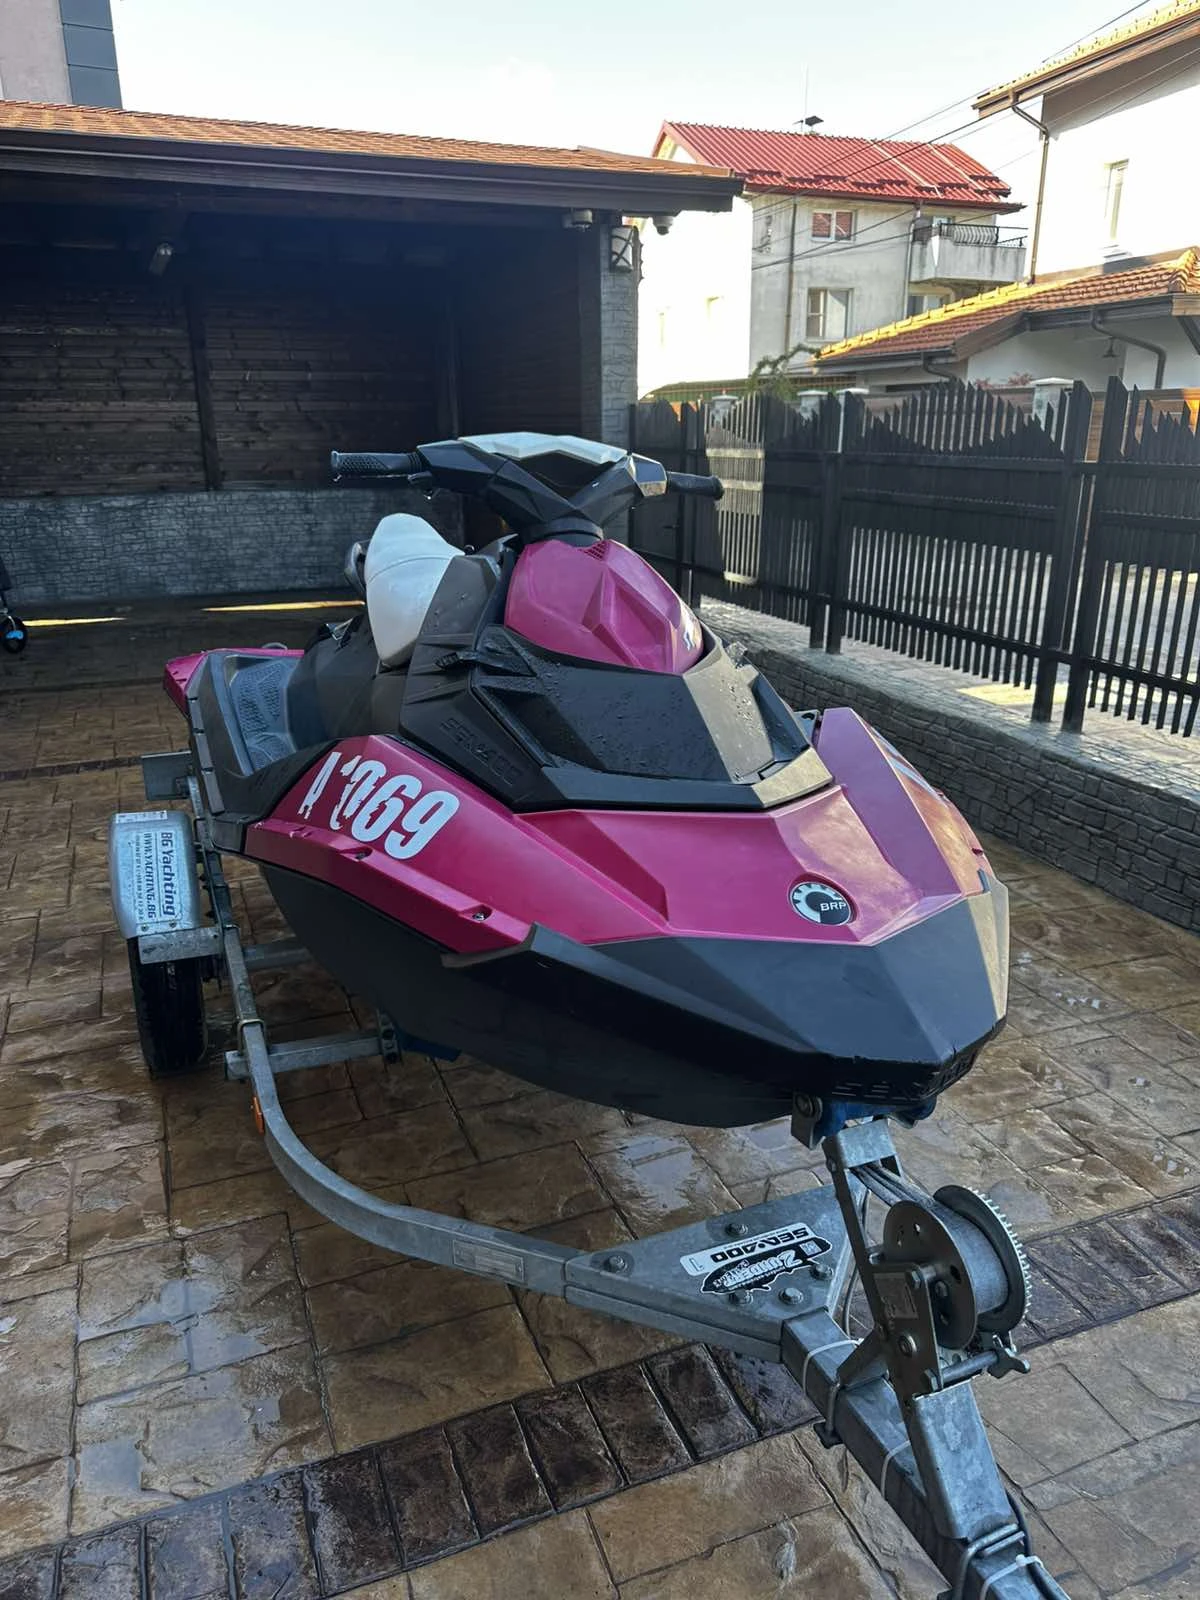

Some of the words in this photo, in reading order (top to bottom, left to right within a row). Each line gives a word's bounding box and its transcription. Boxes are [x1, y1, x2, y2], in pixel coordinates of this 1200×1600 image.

[160, 831, 174, 848] BG
[143, 832, 157, 919] WWW.YACHTING.BG
[161, 849, 177, 917] Yachting
[820, 901, 847, 912] BRP
